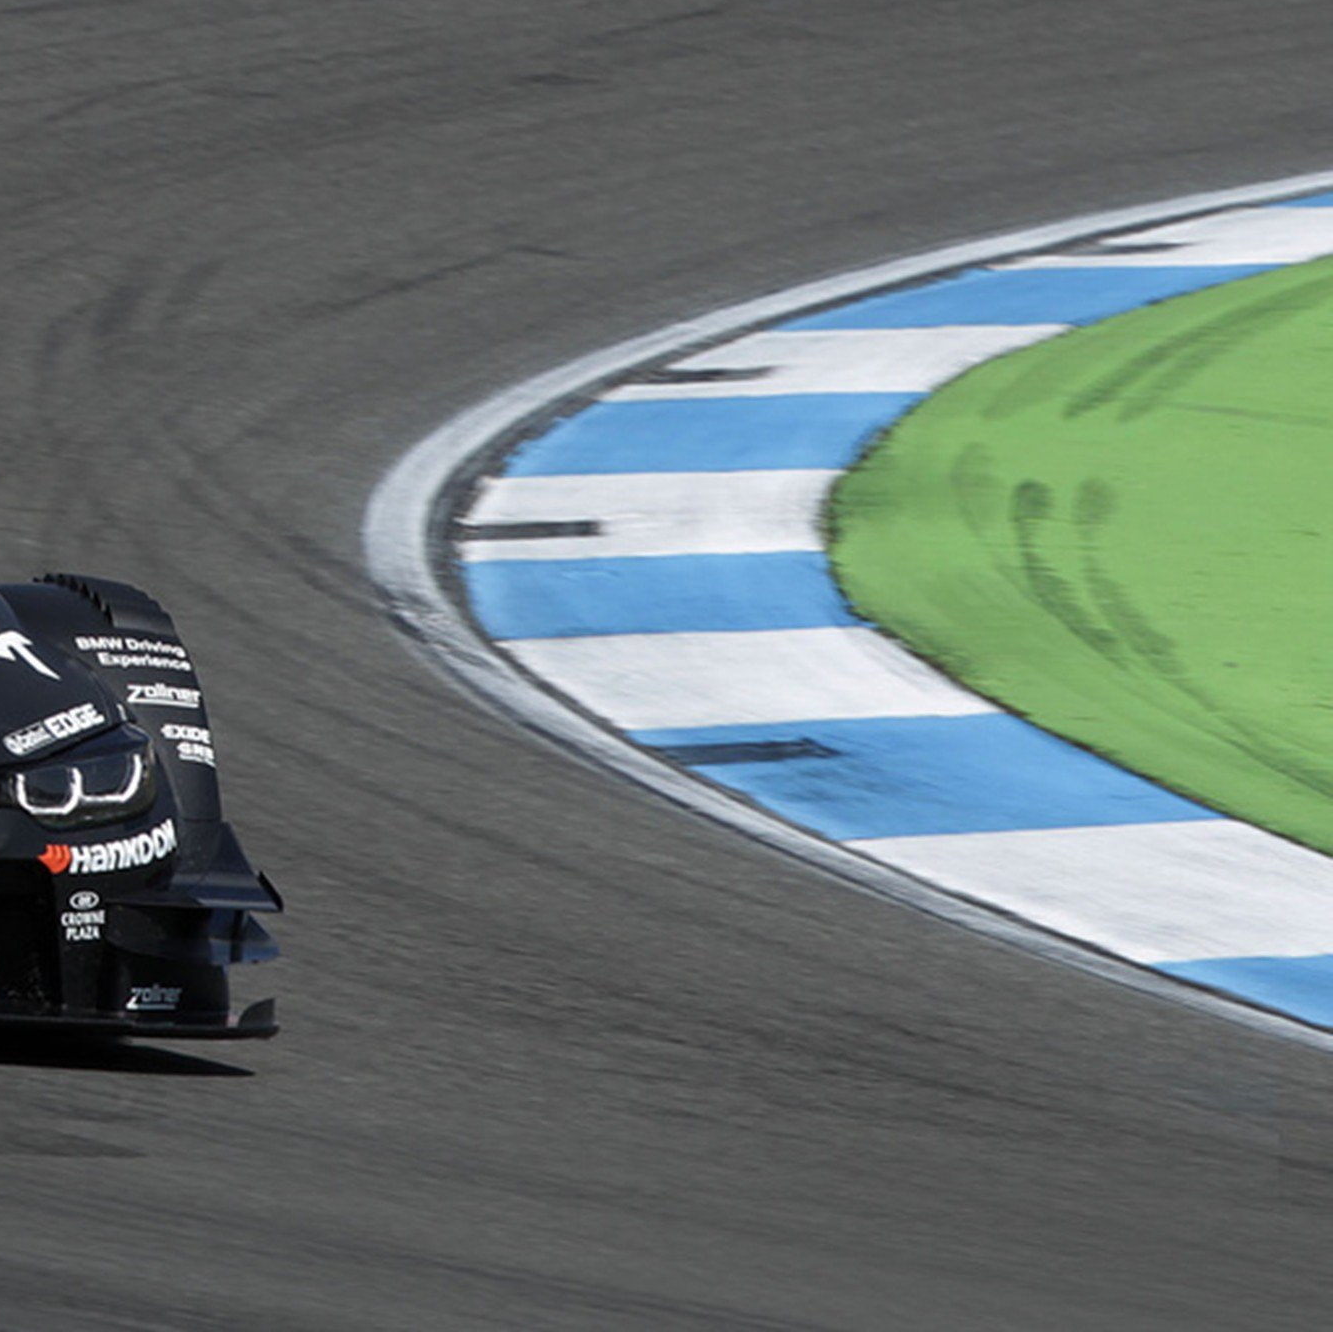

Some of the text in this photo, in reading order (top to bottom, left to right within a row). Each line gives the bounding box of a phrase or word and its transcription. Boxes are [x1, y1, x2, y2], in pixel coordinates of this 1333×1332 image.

[74, 636, 188, 659] BMW Driving
[96, 651, 193, 672] Experience
[43, 702, 106, 739] EDGE
[61, 910, 106, 927] CROWNE
[66, 925, 101, 941] PLAZA
